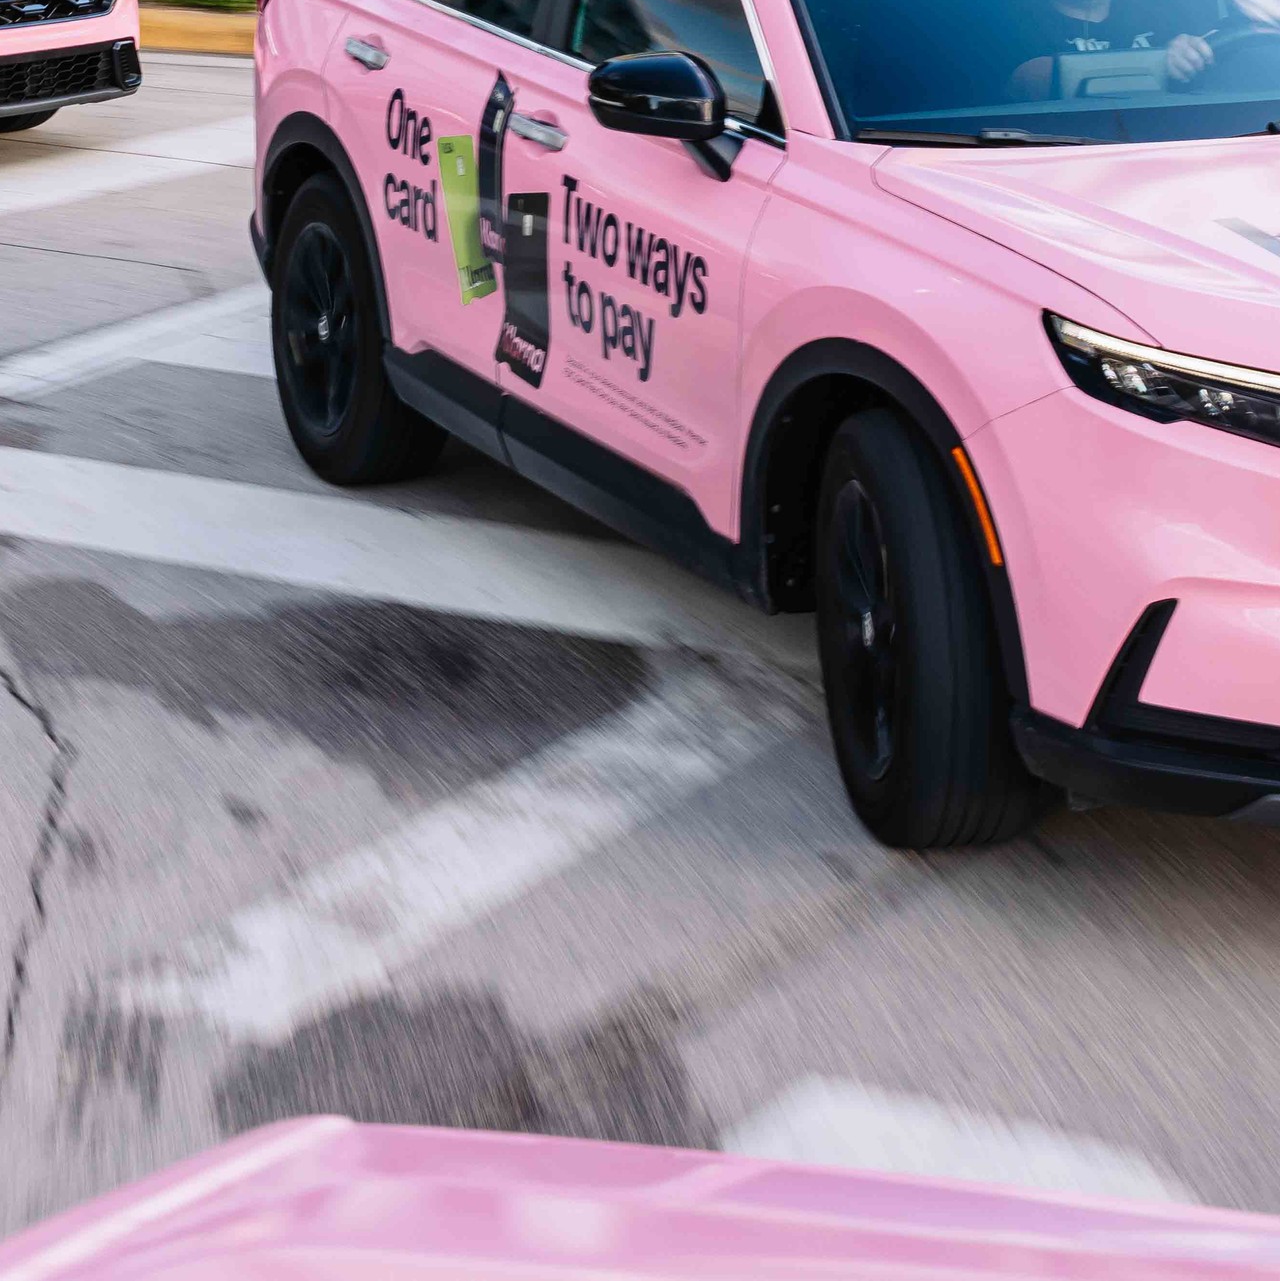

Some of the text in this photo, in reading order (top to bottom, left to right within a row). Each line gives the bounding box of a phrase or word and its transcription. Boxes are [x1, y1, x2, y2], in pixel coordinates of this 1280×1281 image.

[386, 88, 433, 166] One
[384, 172, 439, 243] card
[561, 174, 710, 318] Two ways
[562, 259, 656, 382] to pay
